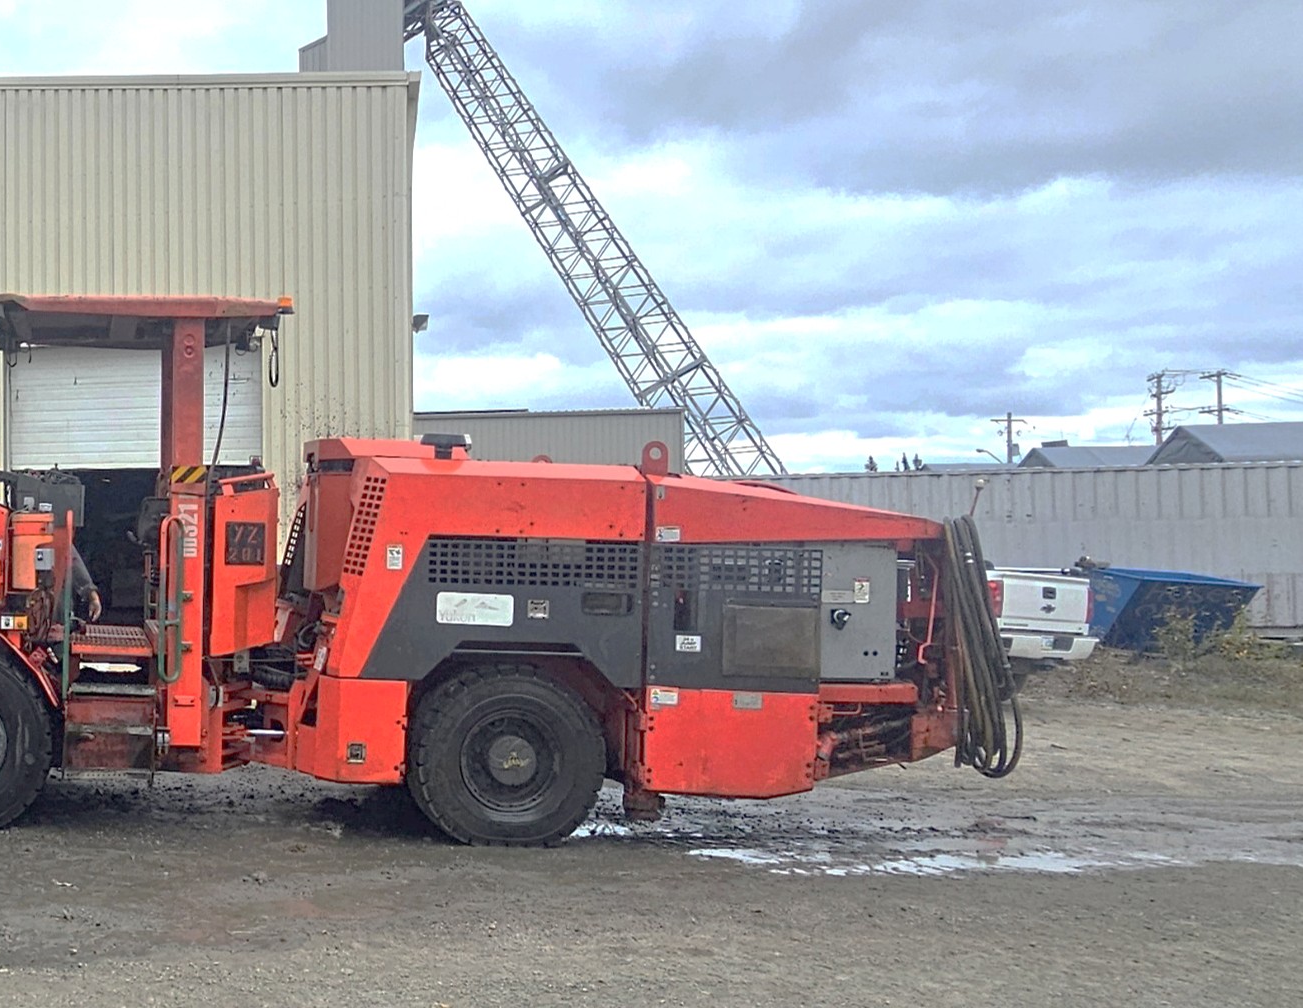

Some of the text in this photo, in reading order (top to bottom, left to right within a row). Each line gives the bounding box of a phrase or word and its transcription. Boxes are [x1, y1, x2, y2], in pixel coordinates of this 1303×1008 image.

[178, 504, 198, 557] DD321
[228, 547, 262, 561] 201
[439, 609, 476, 622] Yukon
